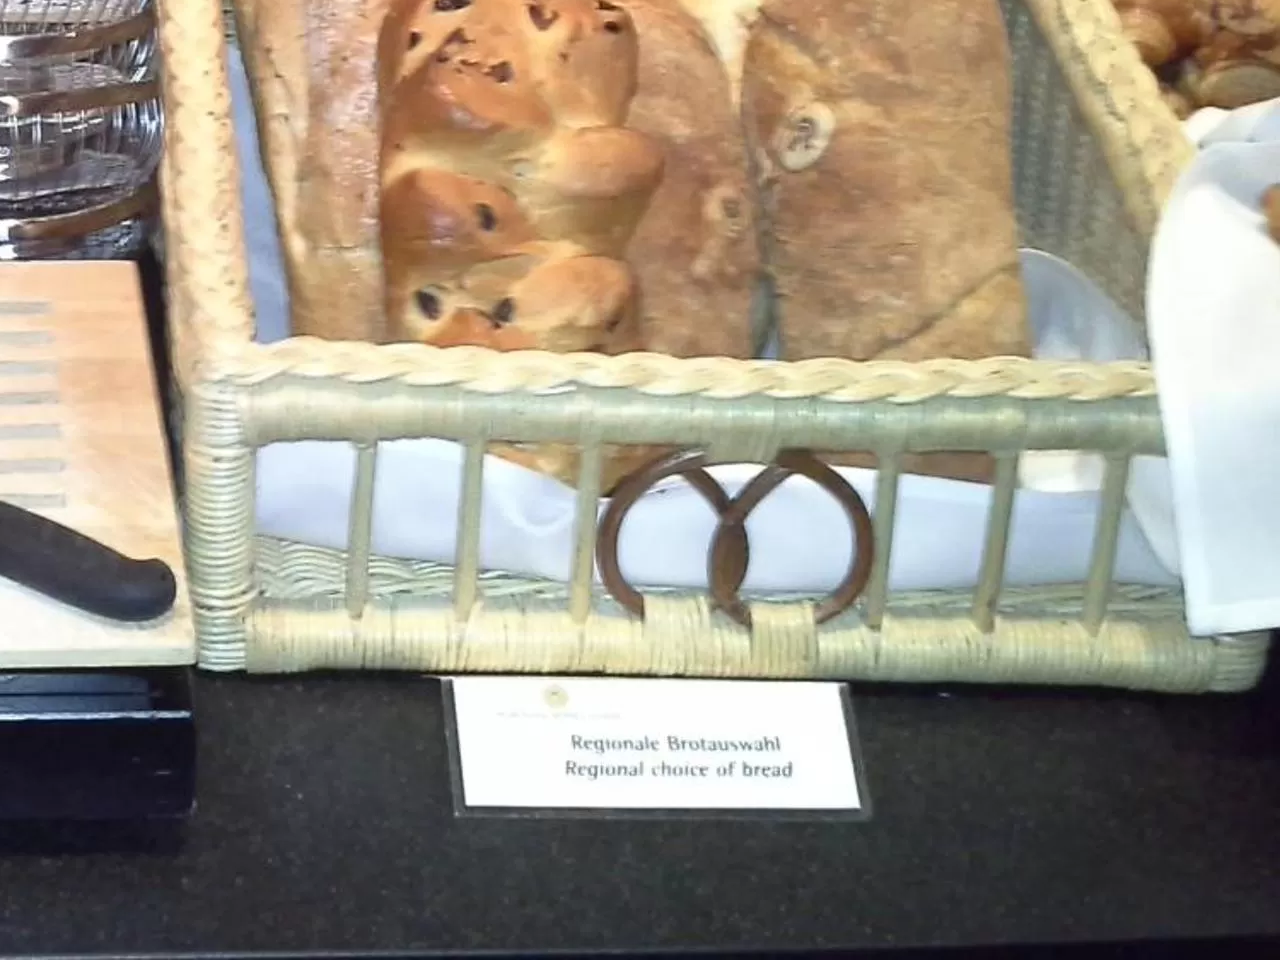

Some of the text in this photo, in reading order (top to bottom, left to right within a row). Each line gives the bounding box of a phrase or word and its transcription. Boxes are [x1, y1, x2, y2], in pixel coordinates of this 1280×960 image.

[570, 734, 781, 754] Regionale Brotauswahl
[565, 759, 793, 780] Regional choice of bread
